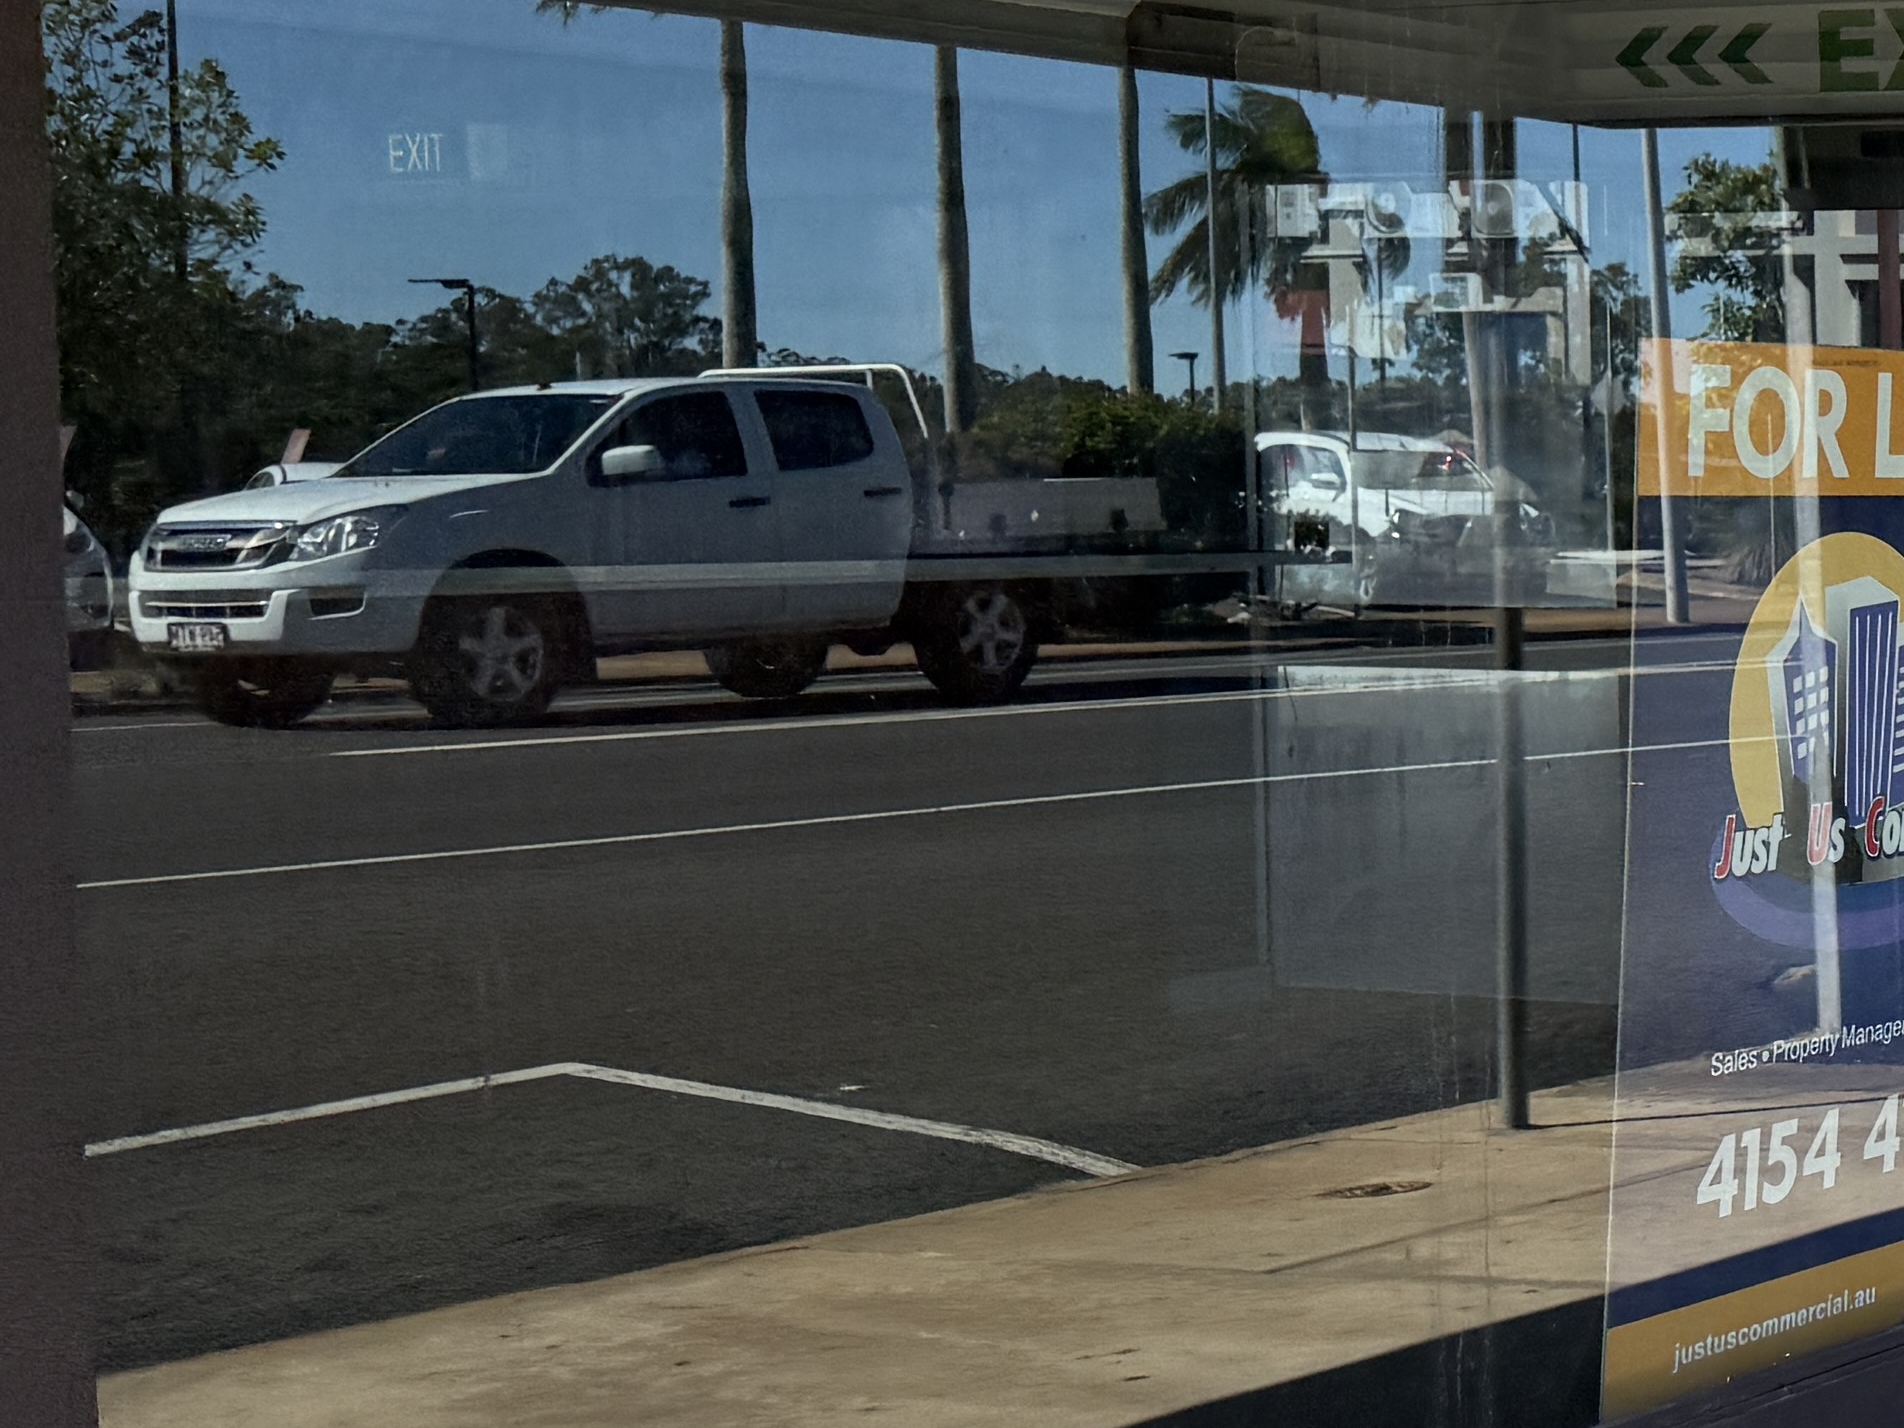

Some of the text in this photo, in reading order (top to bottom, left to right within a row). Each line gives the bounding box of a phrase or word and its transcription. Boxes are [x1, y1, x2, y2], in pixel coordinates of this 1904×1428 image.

[388, 132, 444, 173] EXIT
[1686, 363, 1849, 478] FOR
[1714, 813, 1786, 879] Just
[1806, 801, 1845, 866] Us
[1710, 1048, 1758, 1077] Sales
[1773, 1029, 1841, 1070] Property
[1696, 1109, 1842, 1219] 4154
[1671, 1284, 1878, 1375] justuscommercial.au
